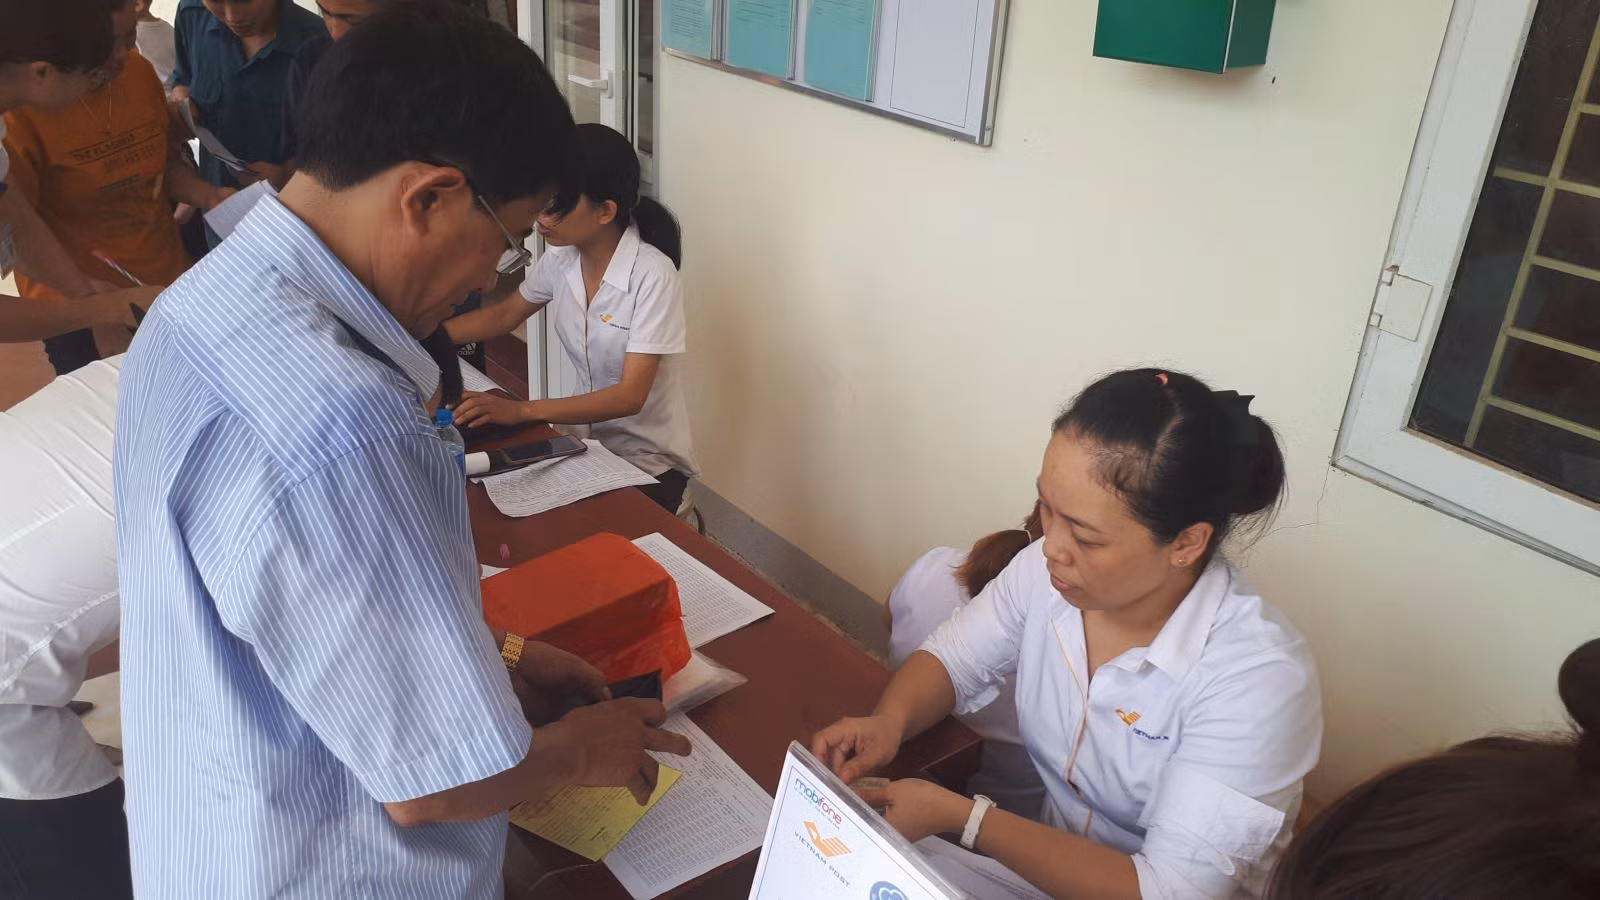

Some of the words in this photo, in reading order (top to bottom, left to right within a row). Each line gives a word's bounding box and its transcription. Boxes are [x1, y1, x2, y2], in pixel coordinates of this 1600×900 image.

[794, 777, 842, 825] mobifone
[794, 831, 827, 866] VIETNAM
[828, 865, 850, 887] POST
